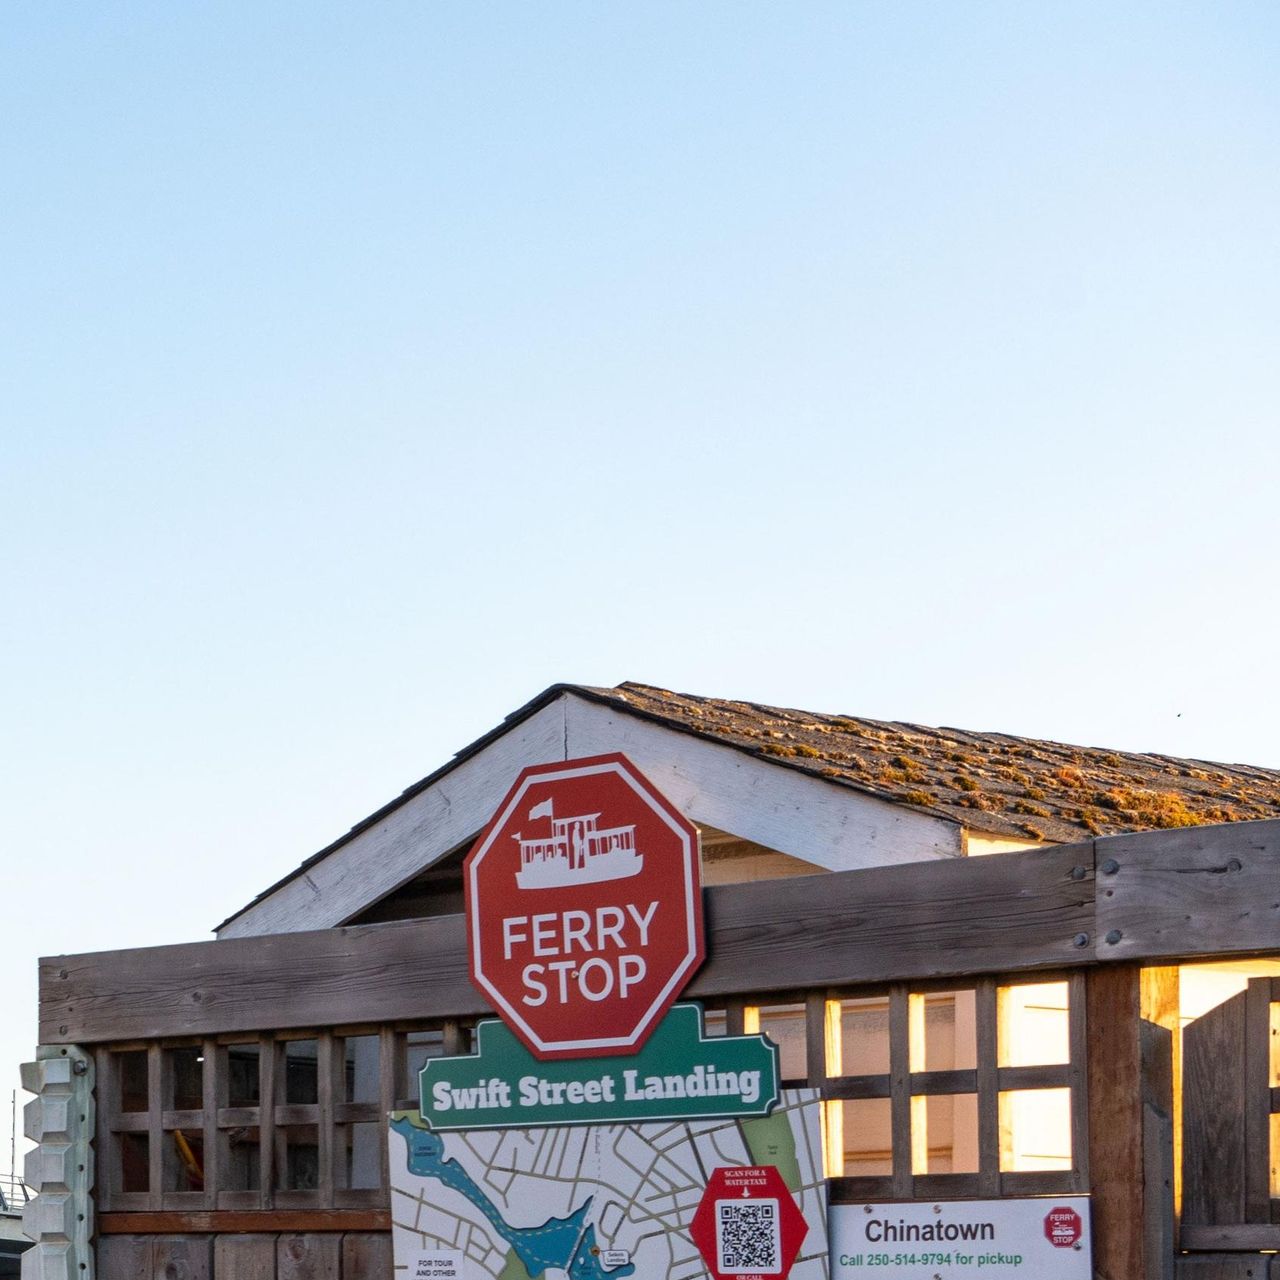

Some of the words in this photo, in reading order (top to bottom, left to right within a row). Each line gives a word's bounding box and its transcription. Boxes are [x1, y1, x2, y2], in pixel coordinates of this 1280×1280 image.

[502, 901, 660, 960] FERRY
[522, 954, 647, 1007] STOP
[432, 1078, 512, 1111] Swift
[518, 1075, 616, 1107] Street
[623, 1065, 761, 1104] Landing
[724, 1170, 745, 1178] SCAN
[1050, 1214, 1076, 1222] FERRY
[865, 1219, 995, 1242] Chinatown
[1053, 1236, 1074, 1244] STOP
[840, 1254, 863, 1266] Call
[867, 1254, 951, 1267] 250-514-9794
[955, 1254, 974, 1265] for
[977, 1253, 1022, 1267] pickup
